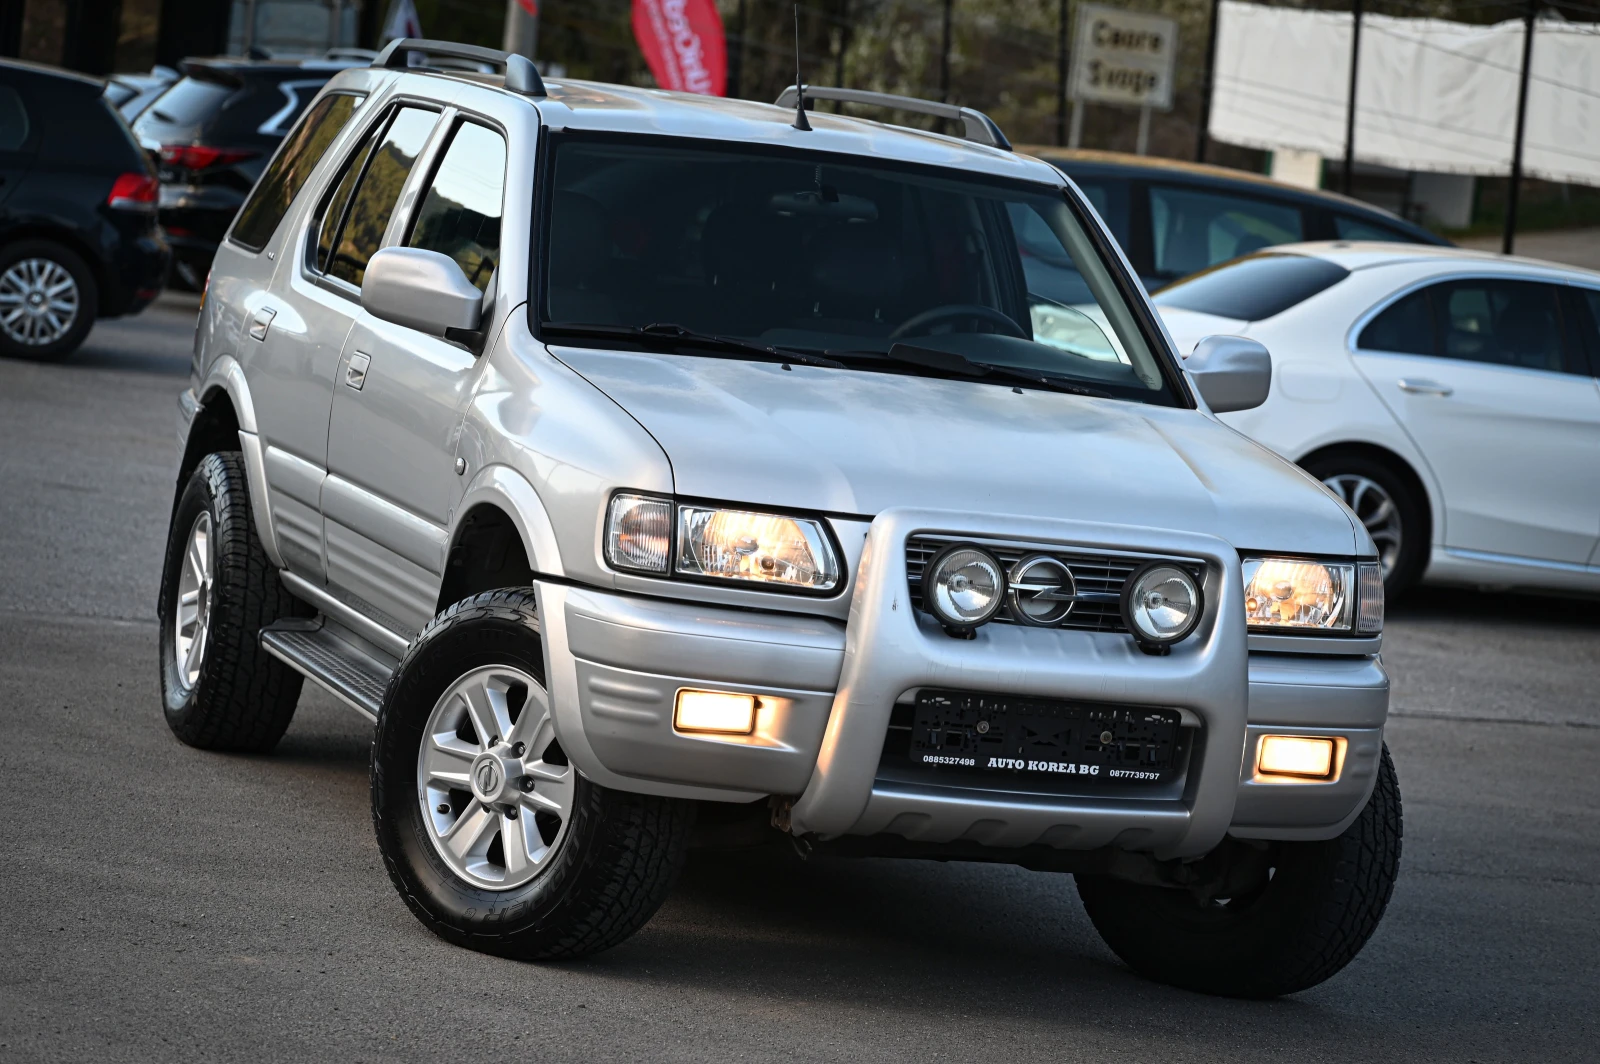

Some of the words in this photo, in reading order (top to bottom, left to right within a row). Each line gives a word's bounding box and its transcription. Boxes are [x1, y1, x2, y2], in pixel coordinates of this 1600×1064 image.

[922, 754, 976, 767] 0885327498
[987, 757, 1025, 770] AUTO
[1027, 760, 1077, 774] KOREA
[1078, 764, 1100, 776] BG
[1109, 769, 1160, 780] 0877739797
